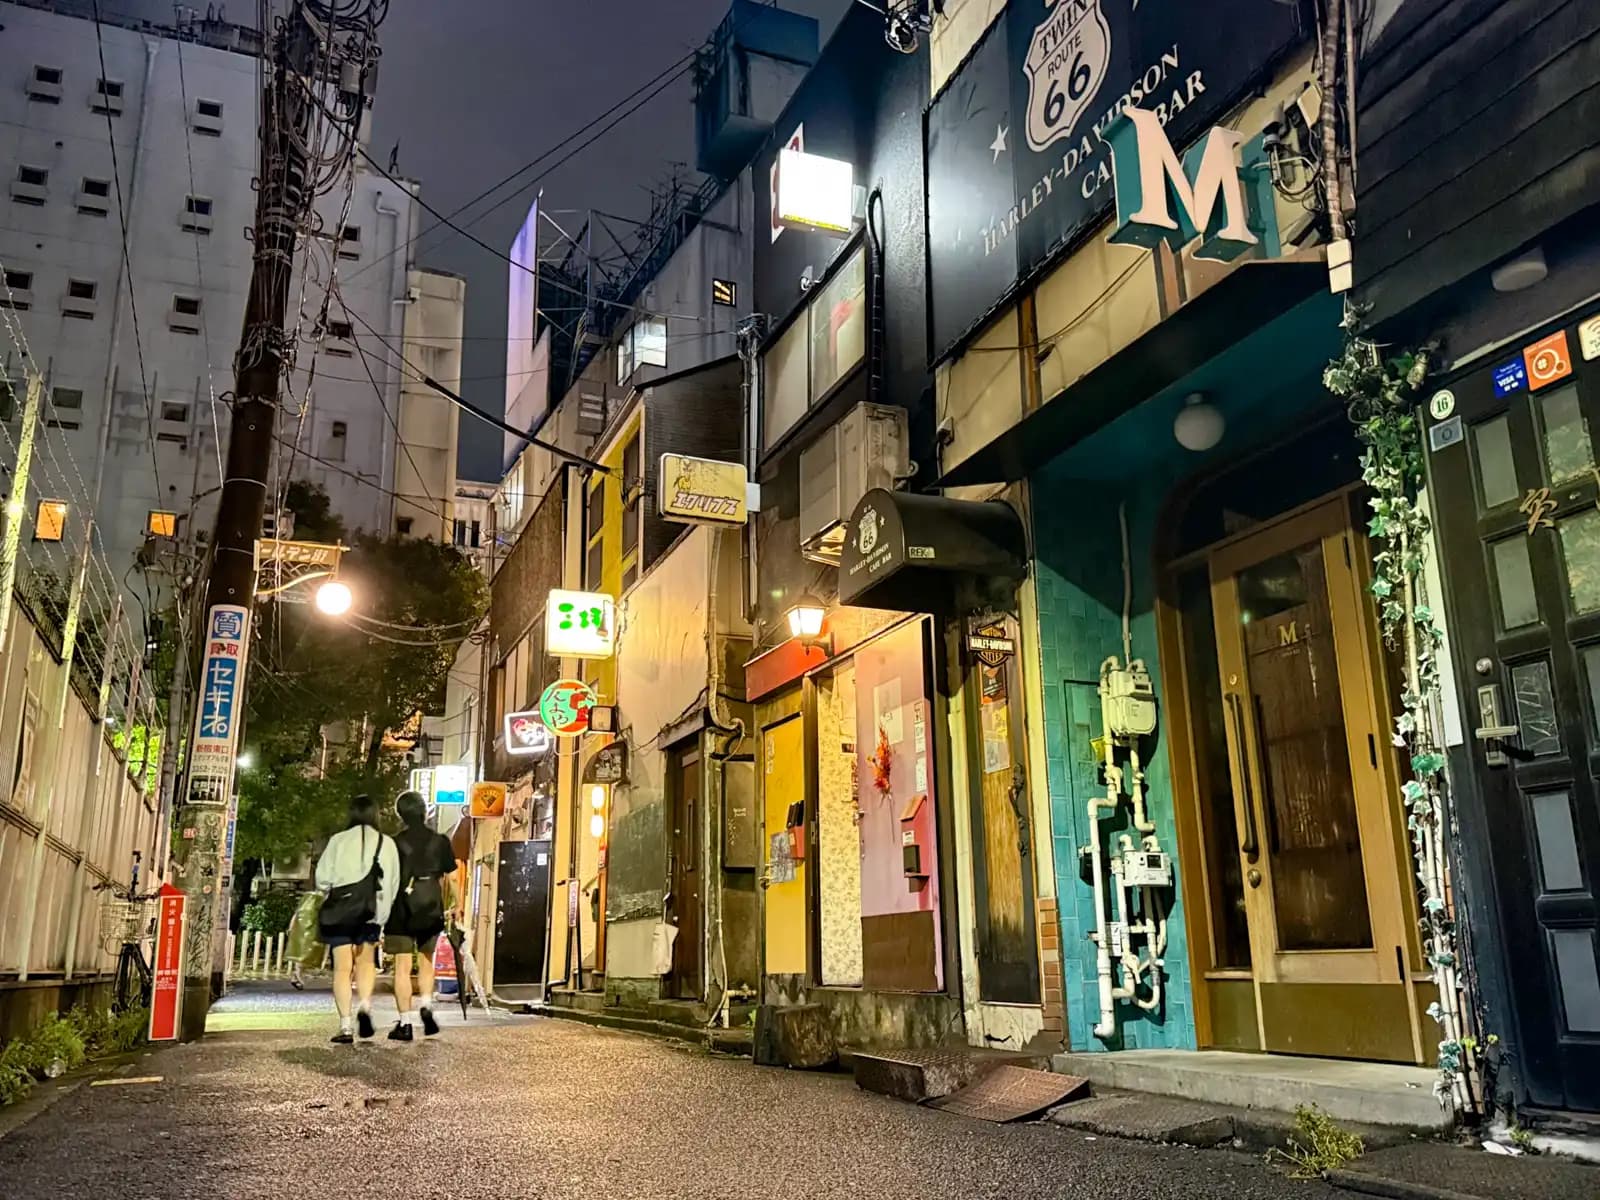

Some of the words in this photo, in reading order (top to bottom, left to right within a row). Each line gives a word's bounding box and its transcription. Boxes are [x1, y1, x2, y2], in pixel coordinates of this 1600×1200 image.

[1040, 0, 1088, 59] TWIN
[1048, 31, 1082, 79] ROUTE
[1044, 51, 1091, 128] 66
[1155, 69, 1207, 128] BAR
[1104, 107, 1259, 258] M
[1437, 397, 1449, 412] 16
[864, 532, 874, 548] 66
[1278, 621, 1298, 646] M
